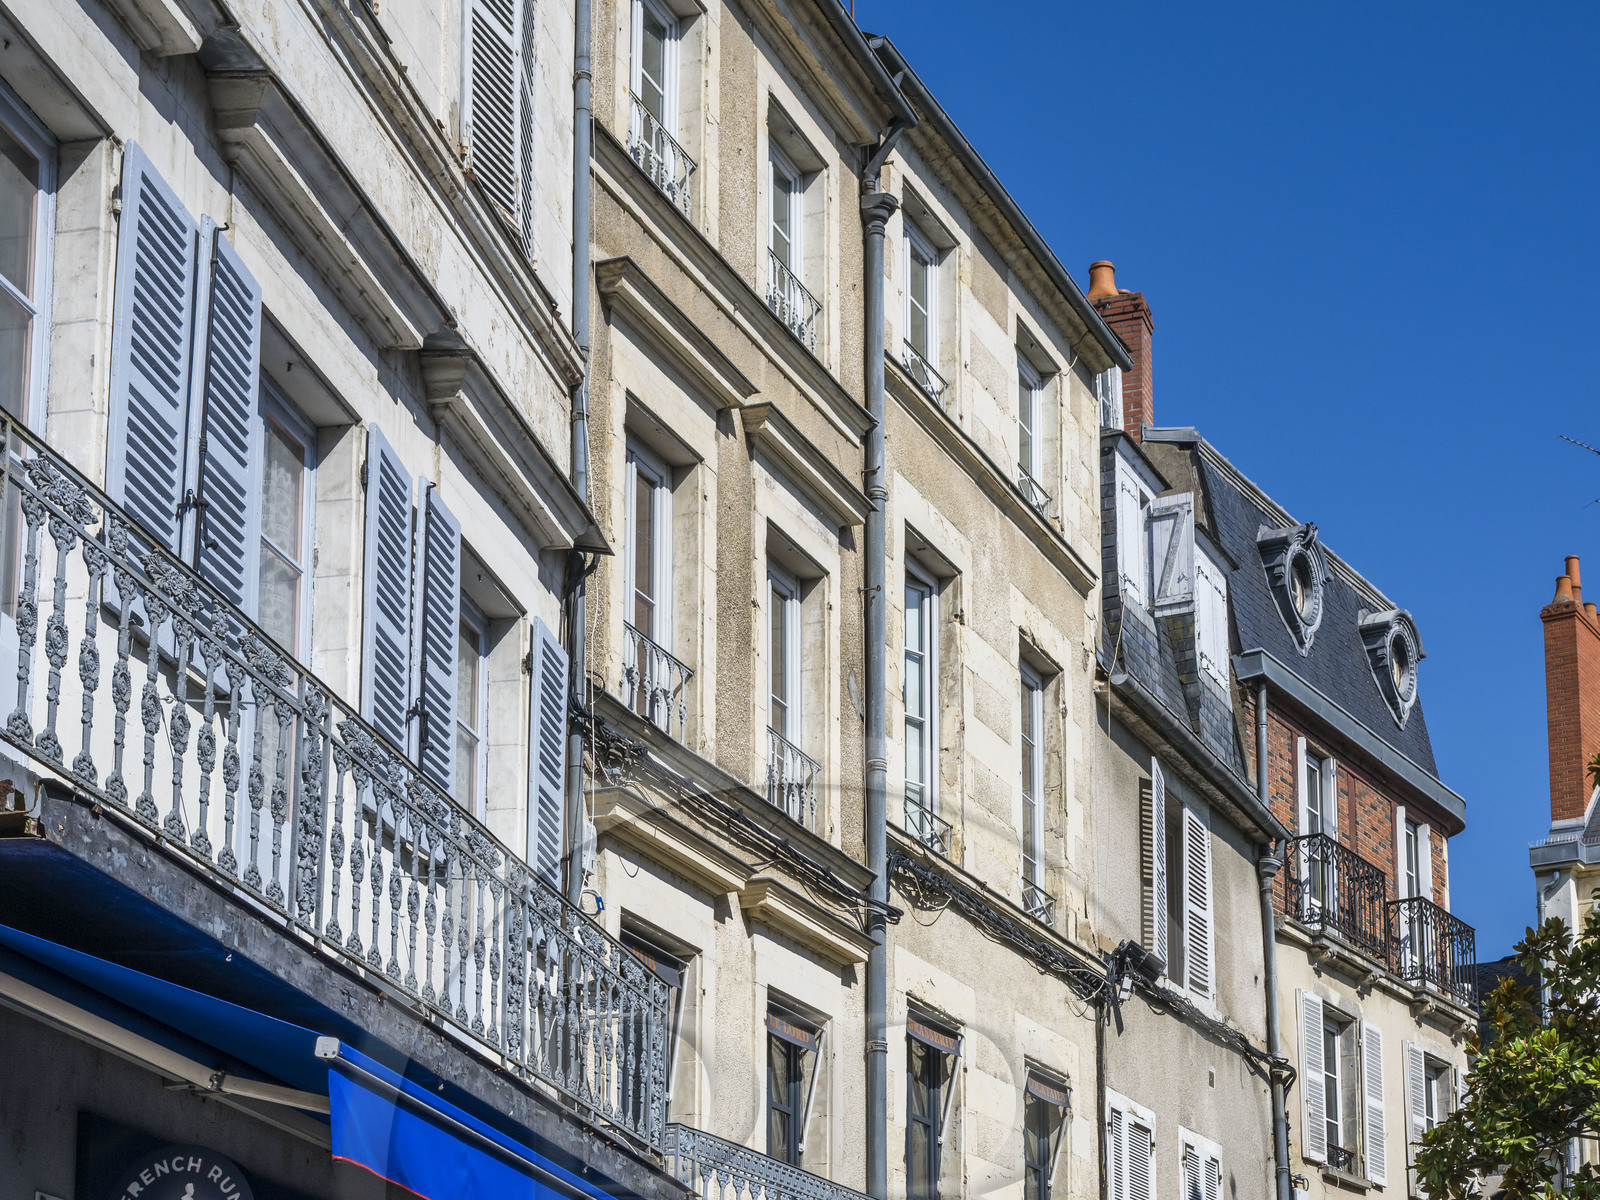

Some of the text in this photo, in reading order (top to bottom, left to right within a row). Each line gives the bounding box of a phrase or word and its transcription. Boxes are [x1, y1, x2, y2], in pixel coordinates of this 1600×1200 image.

[769, 1013, 809, 1043] LE LORD
[907, 1016, 955, 1050] BRASSERIE
